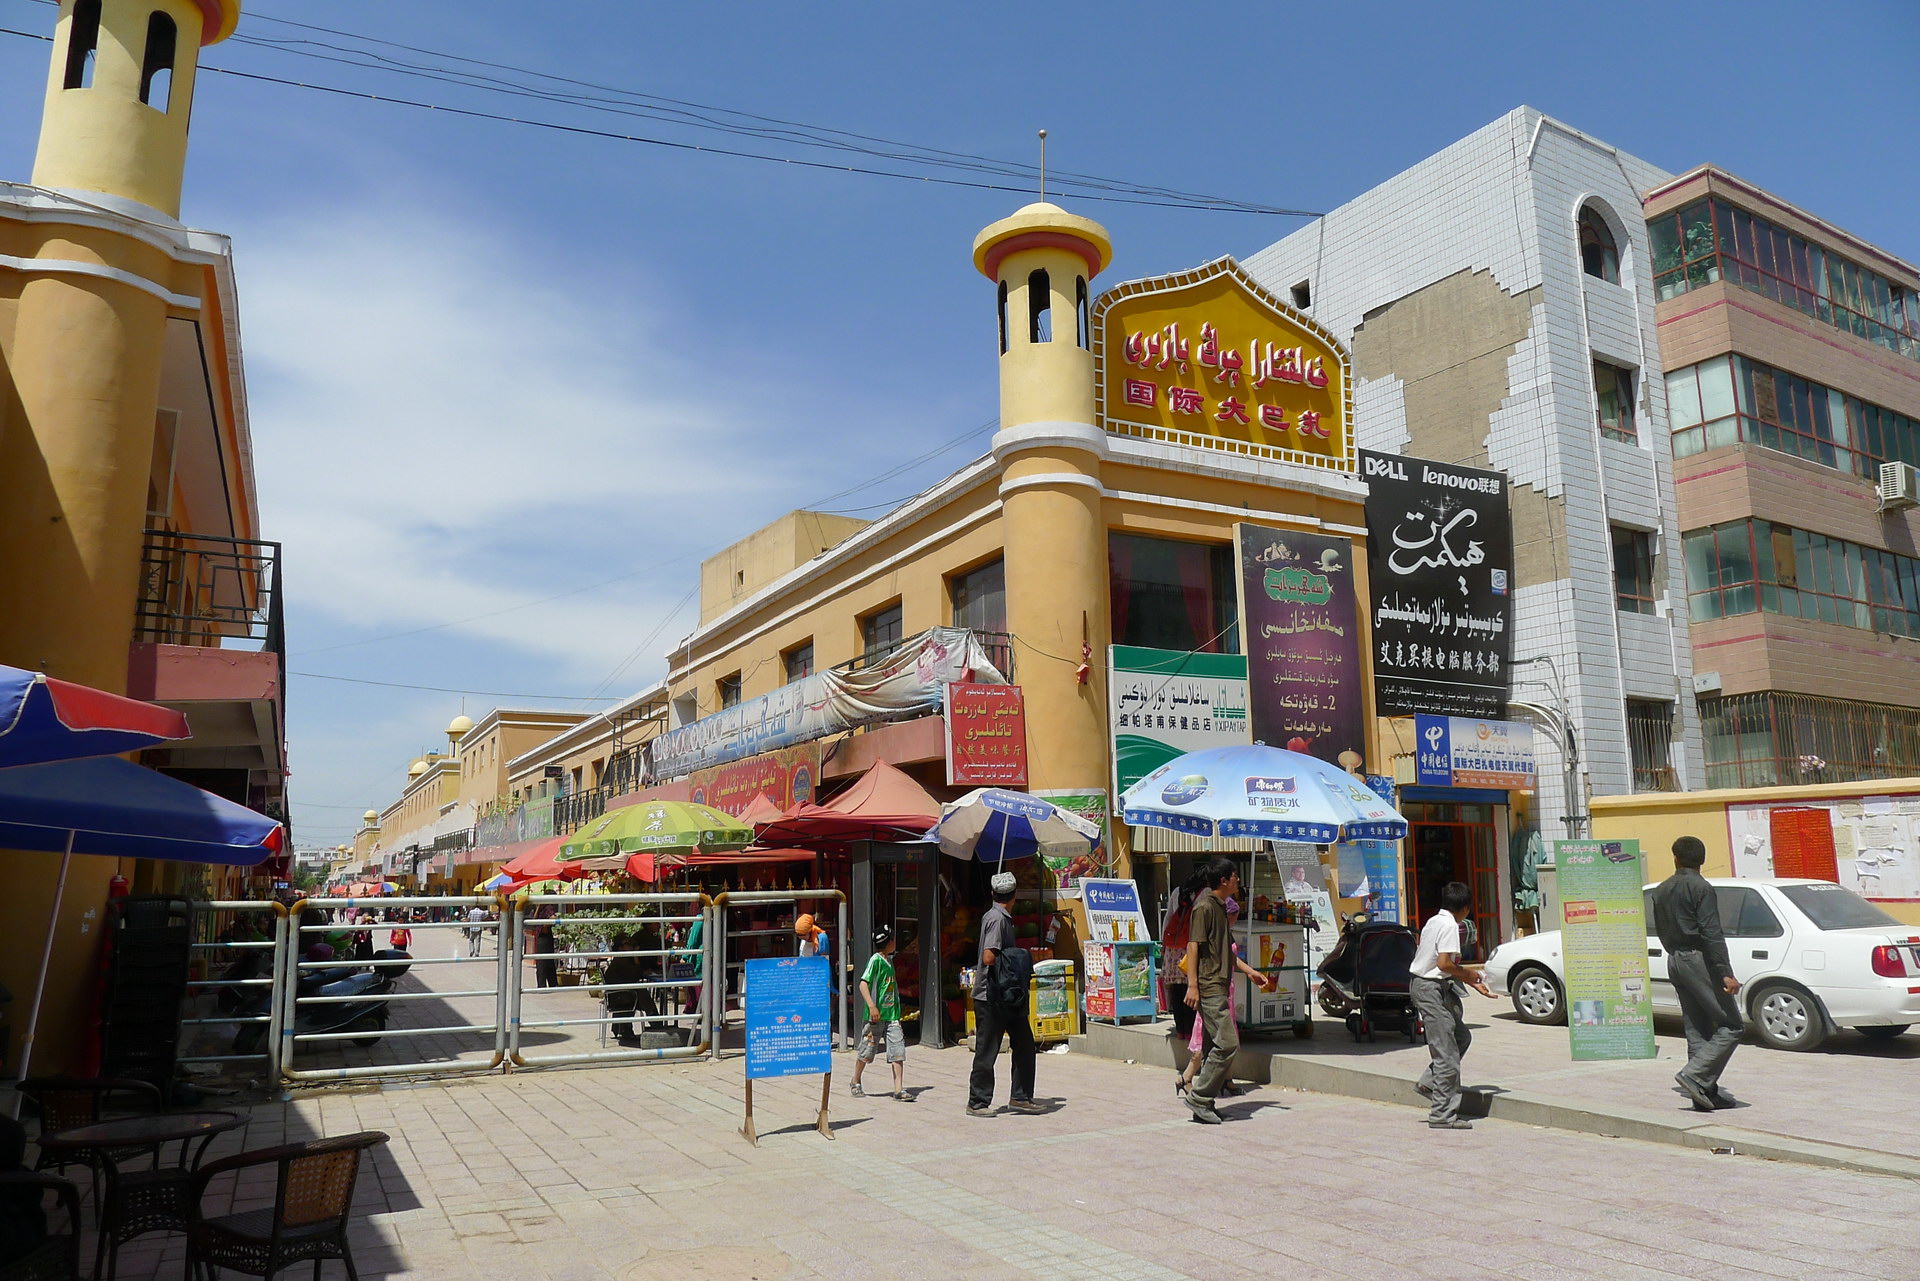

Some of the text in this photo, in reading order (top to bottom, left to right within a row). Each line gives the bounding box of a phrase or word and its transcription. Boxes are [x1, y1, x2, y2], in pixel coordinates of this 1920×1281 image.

[1122, 321, 1191, 376] بازىرى
[1196, 320, 1244, 388] چوڭ
[1122, 377, 1332, 440] 国际大巴扎
[1364, 456, 1409, 482] DELL
[1379, 639, 1501, 678] 艾克买提电脑服务部
[1247, 796, 1301, 808] 矿物质水
[1272, 825, 1331, 839] 生活更健康
